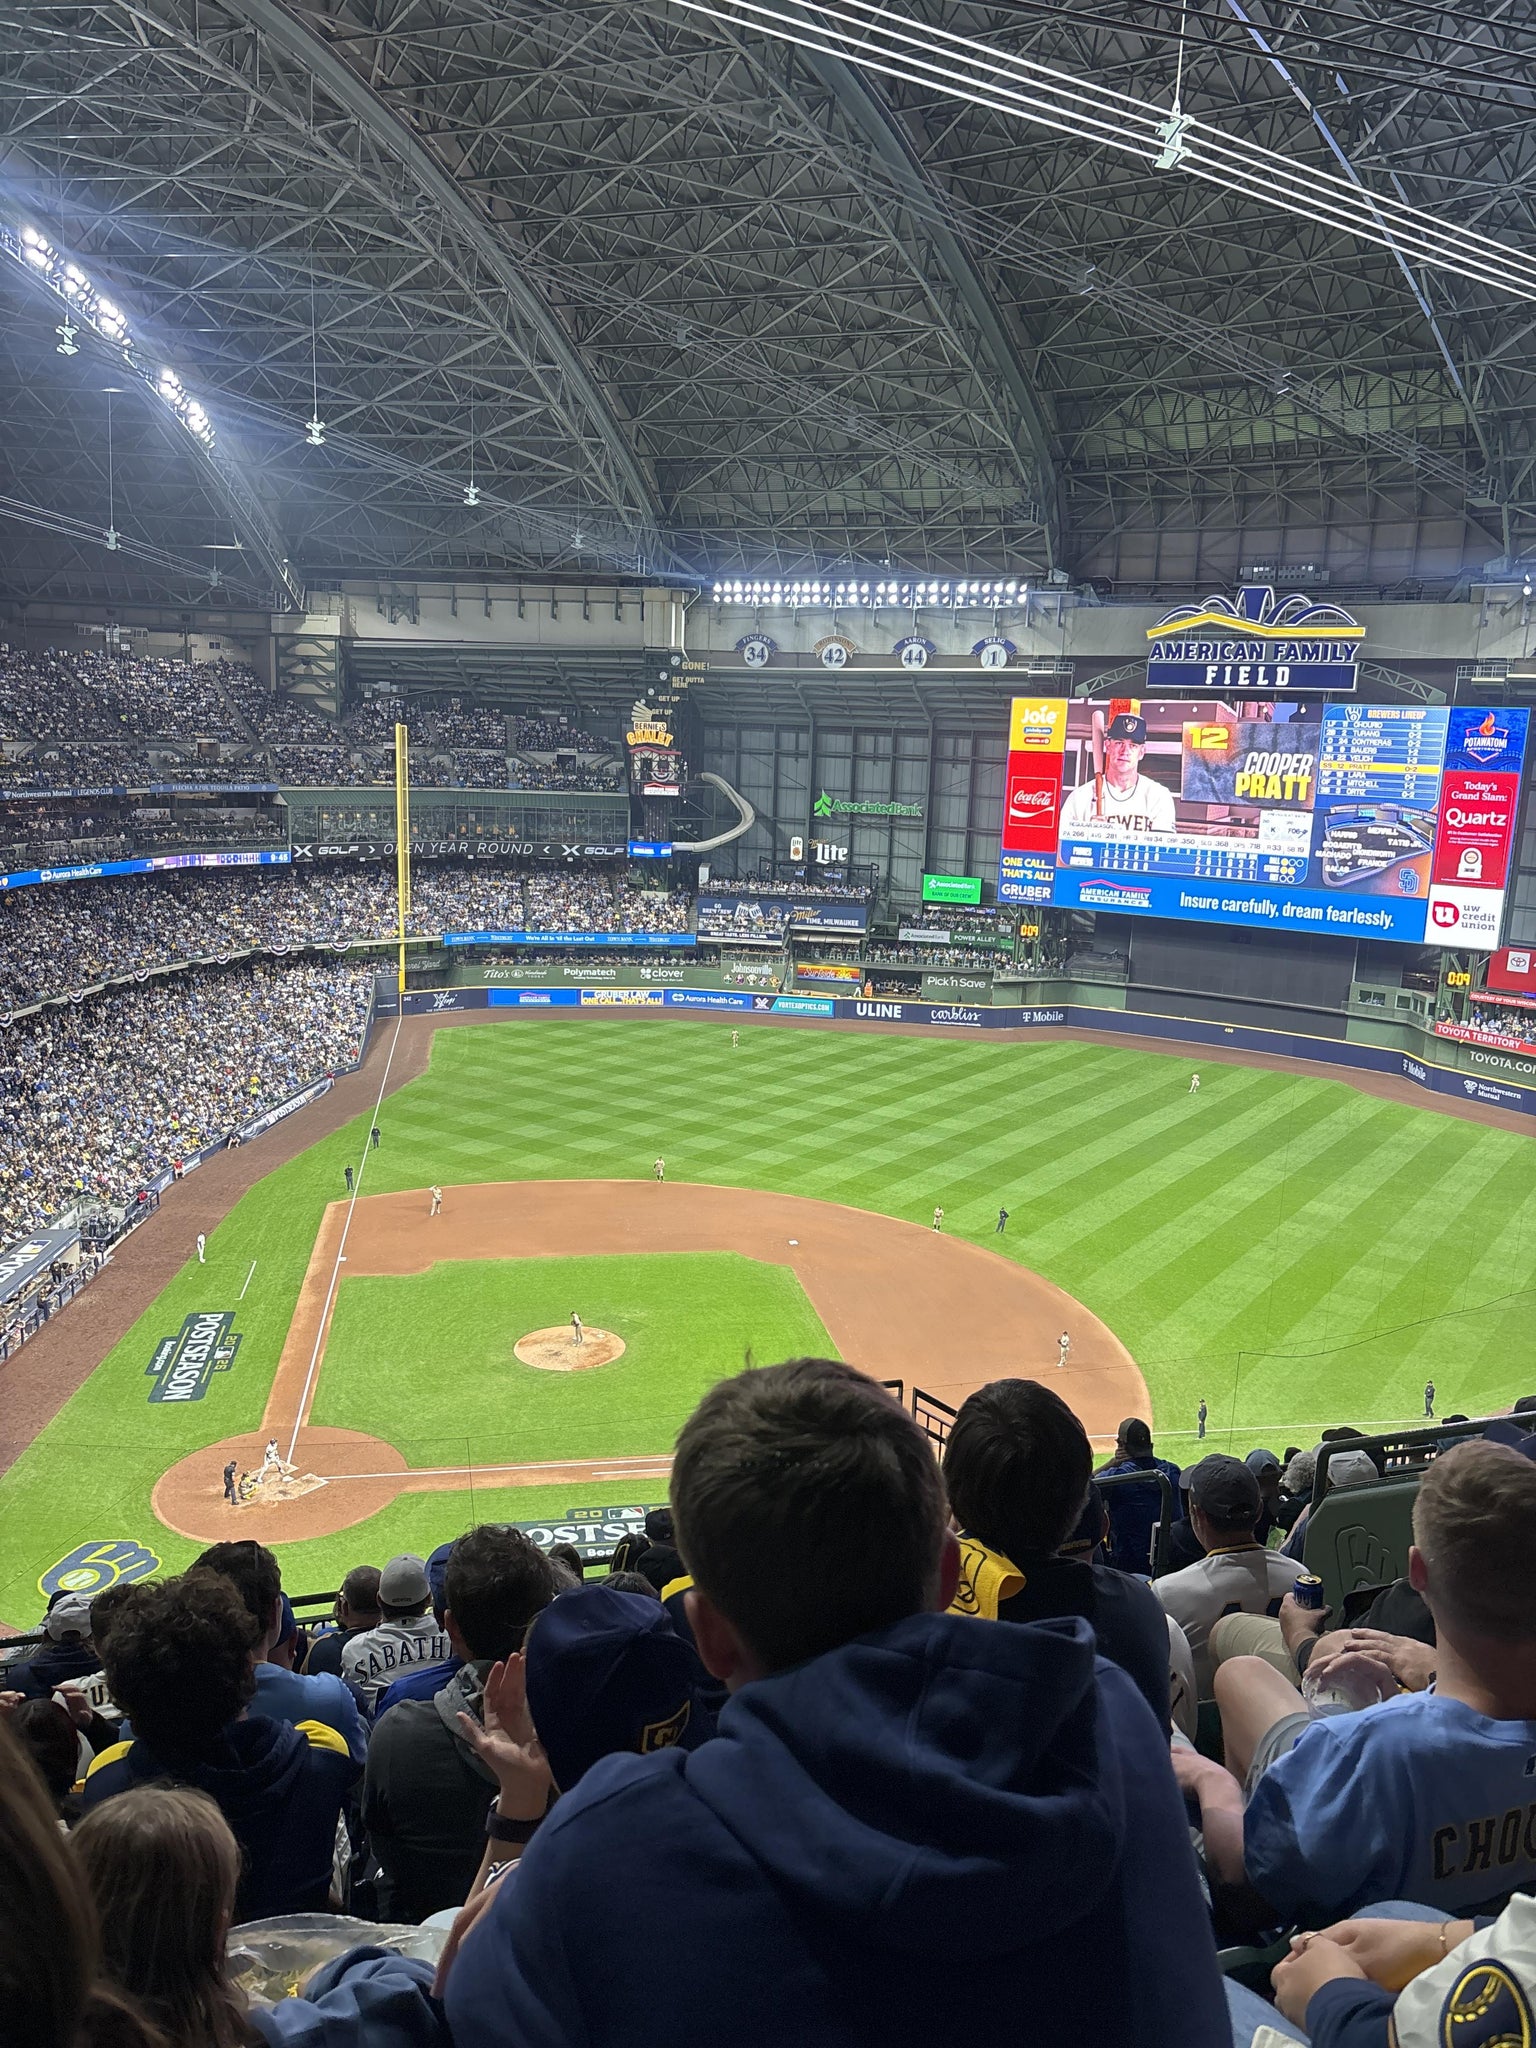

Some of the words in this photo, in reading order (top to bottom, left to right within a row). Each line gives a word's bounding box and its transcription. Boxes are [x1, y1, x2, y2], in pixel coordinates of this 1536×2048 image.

[742, 633, 771, 645] FINGERS
[904, 637, 927, 645] AARON
[984, 637, 1005, 645] SELIG
[746, 646, 766, 662] 34
[823, 647, 844, 663] 42
[903, 649, 923, 664] 44
[1150, 641, 1266, 662] AMERICAN
[1273, 642, 1360, 663] FAMILY
[990, 651, 998, 666] 1
[681, 661, 710, 671] GONE!
[672, 676, 685, 684] GET
[1205, 665, 1290, 686] FIELD
[1021, 705, 1058, 725] Joie
[1367, 709, 1401, 719] BREWERS
[634, 722, 667, 731] BERNIE'S
[626, 730, 674, 747] CHALET
[1189, 727, 1229, 750] 12
[1463, 737, 1508, 749] POTAWATOMI
[1243, 752, 1314, 777] COOPER
[1235, 772, 1312, 801] PRATT
[1346, 780, 1379, 788] MITCHELL
[1464, 781, 1498, 792] Today's
[1451, 790, 1480, 800] Grand
[1481, 791, 1508, 802] Slam:
[1445, 807, 1509, 828] Quartz
[318, 845, 359, 855] GOLF
[383, 843, 425, 855] OEN
[430, 842, 468, 854] YEAR
[477, 843, 534, 855] ROUND
[584, 847, 625, 856] GOLF
[815, 843, 848, 865] Lite
[1002, 856, 1023, 867] ONE
[52, 869, 71, 880] Aurora
[71, 868, 89, 879] Health
[89, 866, 103, 876] Care
[1001, 868, 1033, 880] THAT'S
[1001, 883, 1051, 899] GRUBER
[1080, 888, 1120, 898] AMERICAN
[1121, 891, 1150, 900] FAMILY
[1085, 896, 1143, 905] INSURANCE
[1179, 892, 1219, 910] Insure
[1221, 898, 1279, 919] carefully,
[1281, 902, 1323, 921] dream
[1325, 905, 1395, 930] fearlessly.
[1463, 904, 1481, 912] uw
[823, 919, 859, 927] MILWAUKEE
[1462, 913, 1495, 922] credit
[1020, 924, 1039, 937] 0:09
[1461, 921, 1495, 931] union
[483, 969, 510, 979] Tito's
[563, 968, 616, 977] Polymatech
[652, 968, 684, 978] clover
[731, 962, 773, 975] Johnsonville
[927, 976, 949, 987] Pick
[959, 978, 986, 989] Save
[1448, 972, 1471, 986] 0:09
[594, 991, 630, 999] GRUBER
[684, 994, 706, 1004] Aurora
[706, 996, 728, 1005] Health
[728, 998, 744, 1006] Care
[778, 1001, 830, 1011] VORTEXOPTICS.COM
[856, 1002, 902, 1019] ULINE
[930, 1007, 982, 1021] carbliss
[1032, 1010, 1064, 1021] Mobile
[1437, 1024, 1470, 1039] TOYOTA
[1472, 1031, 1521, 1049] TERRITORY
[1408, 1061, 1427, 1081] Mobile
[1477, 1090, 1500, 1101] Mutual
[1478, 1083, 1521, 1100] Northwestern
[223, 1335, 238, 1346] 20
[162, 1313, 225, 1401] POSTSEASON
[214, 1359, 229, 1370] 26
[574, 1510, 603, 1519] 20
[525, 1522, 648, 1546] OSTSE
